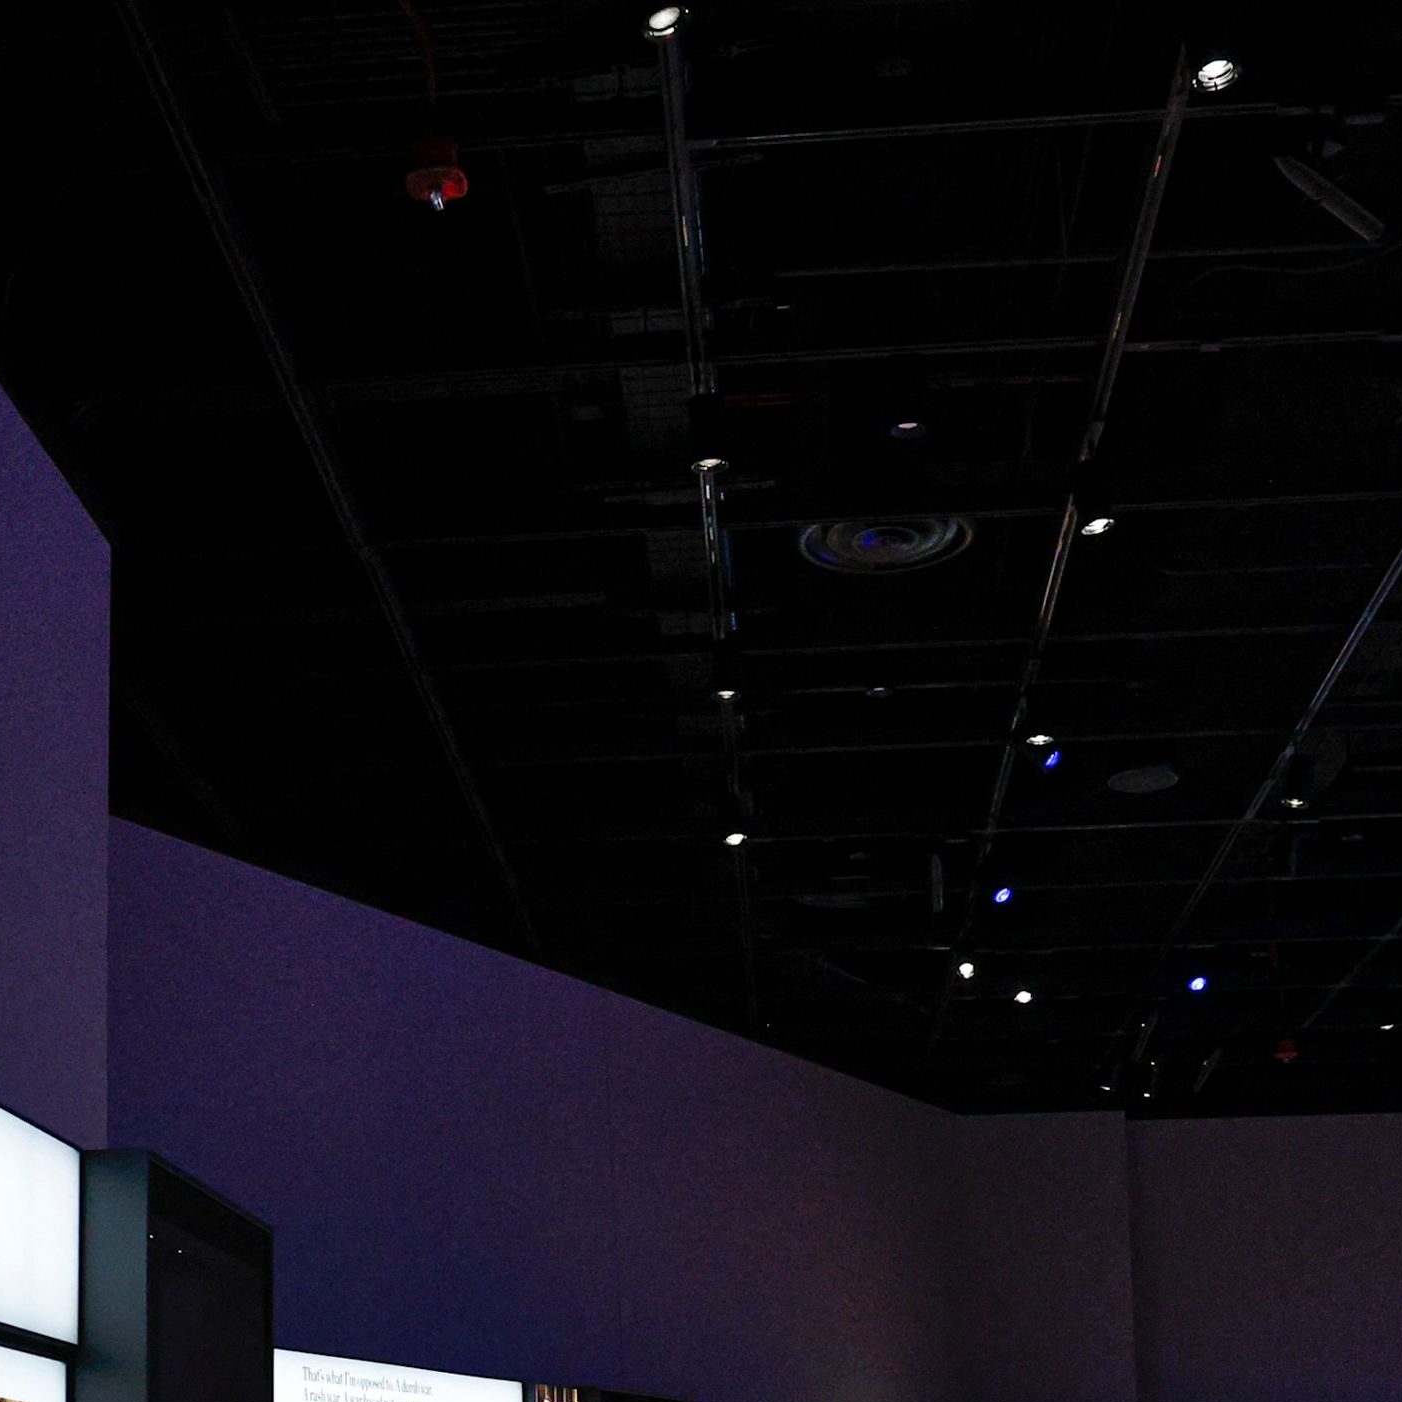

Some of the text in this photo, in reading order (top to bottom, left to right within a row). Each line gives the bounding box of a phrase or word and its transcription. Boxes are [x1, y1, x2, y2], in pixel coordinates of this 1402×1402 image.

[303, 1366, 325, 1381] That's
[326, 1371, 344, 1383] what
[356, 1376, 384, 1390] opposed
